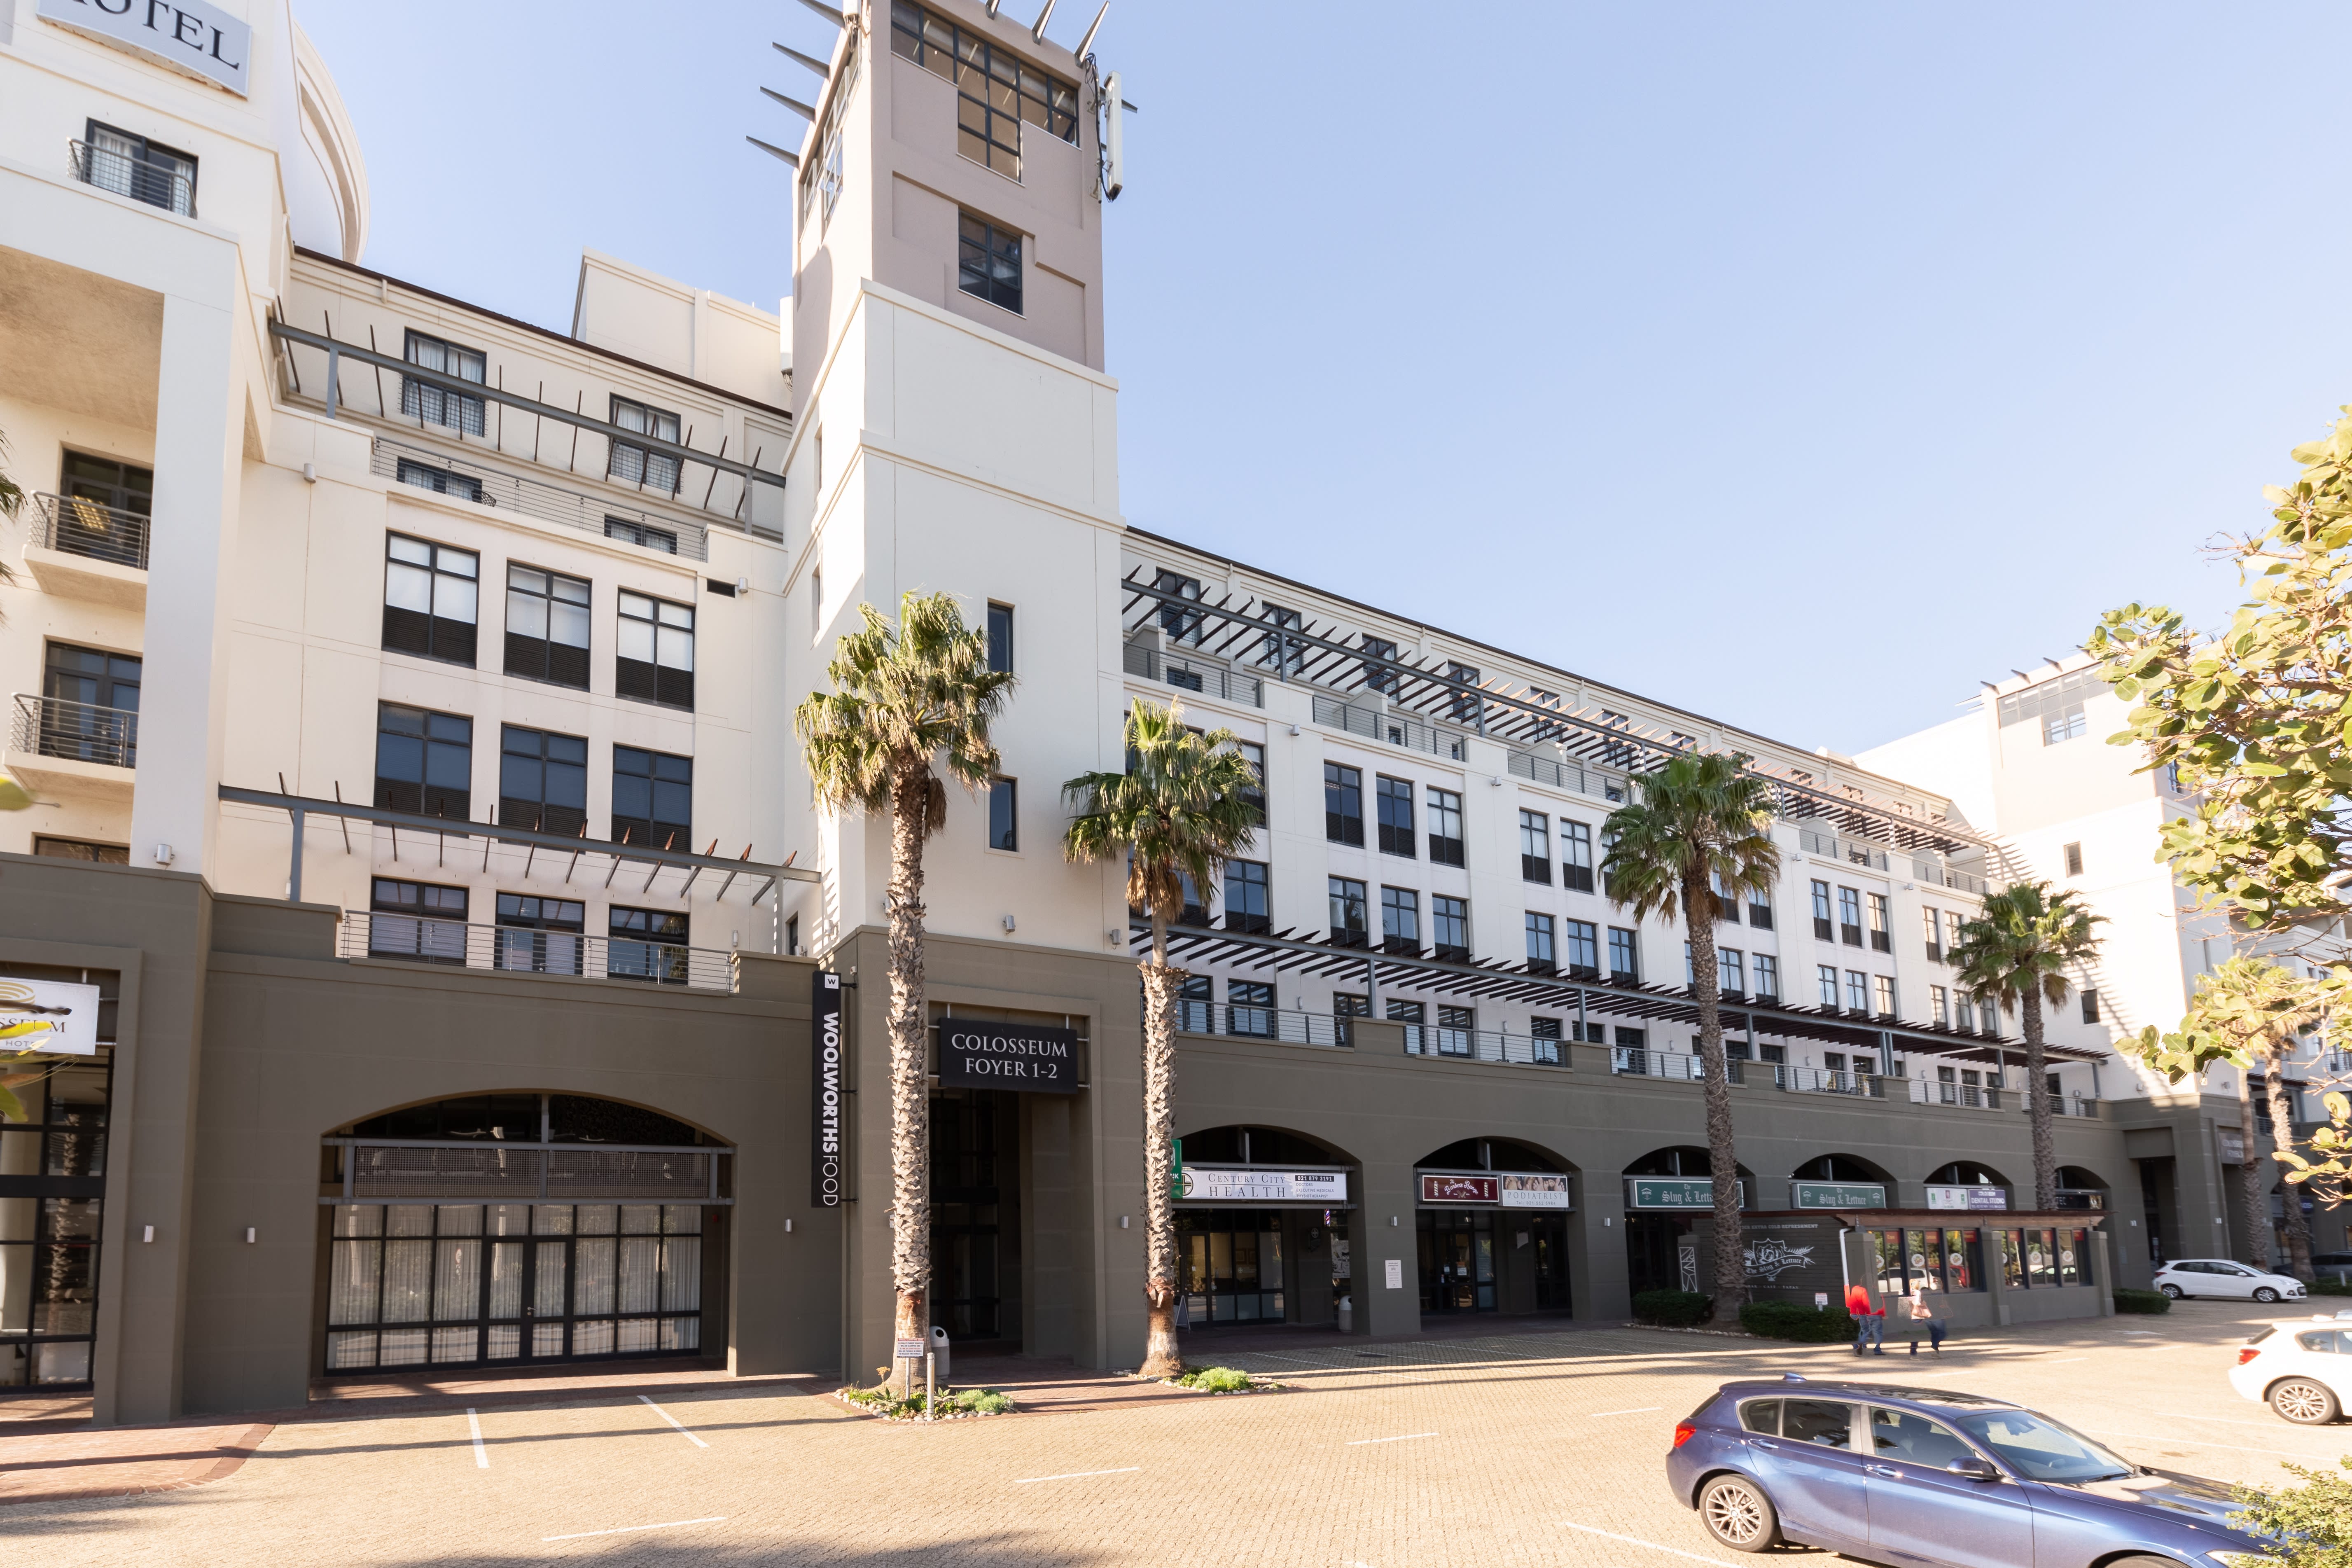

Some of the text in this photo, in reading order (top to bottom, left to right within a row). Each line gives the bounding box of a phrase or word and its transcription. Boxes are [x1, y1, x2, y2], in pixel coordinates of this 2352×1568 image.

[73, 0, 239, 70] TEL
[952, 1034, 1068, 1057] COLOSSEUM
[965, 1058, 1057, 1078] FOYER 1-2
[1209, 1186, 1285, 1197] HEALTH
[1464, 1180, 1478, 1194] Range
[1662, 1191, 1682, 1204] Slug
[1684, 1191, 1692, 1202] &
[1819, 1194, 1866, 1206] Slug & Lettuce
